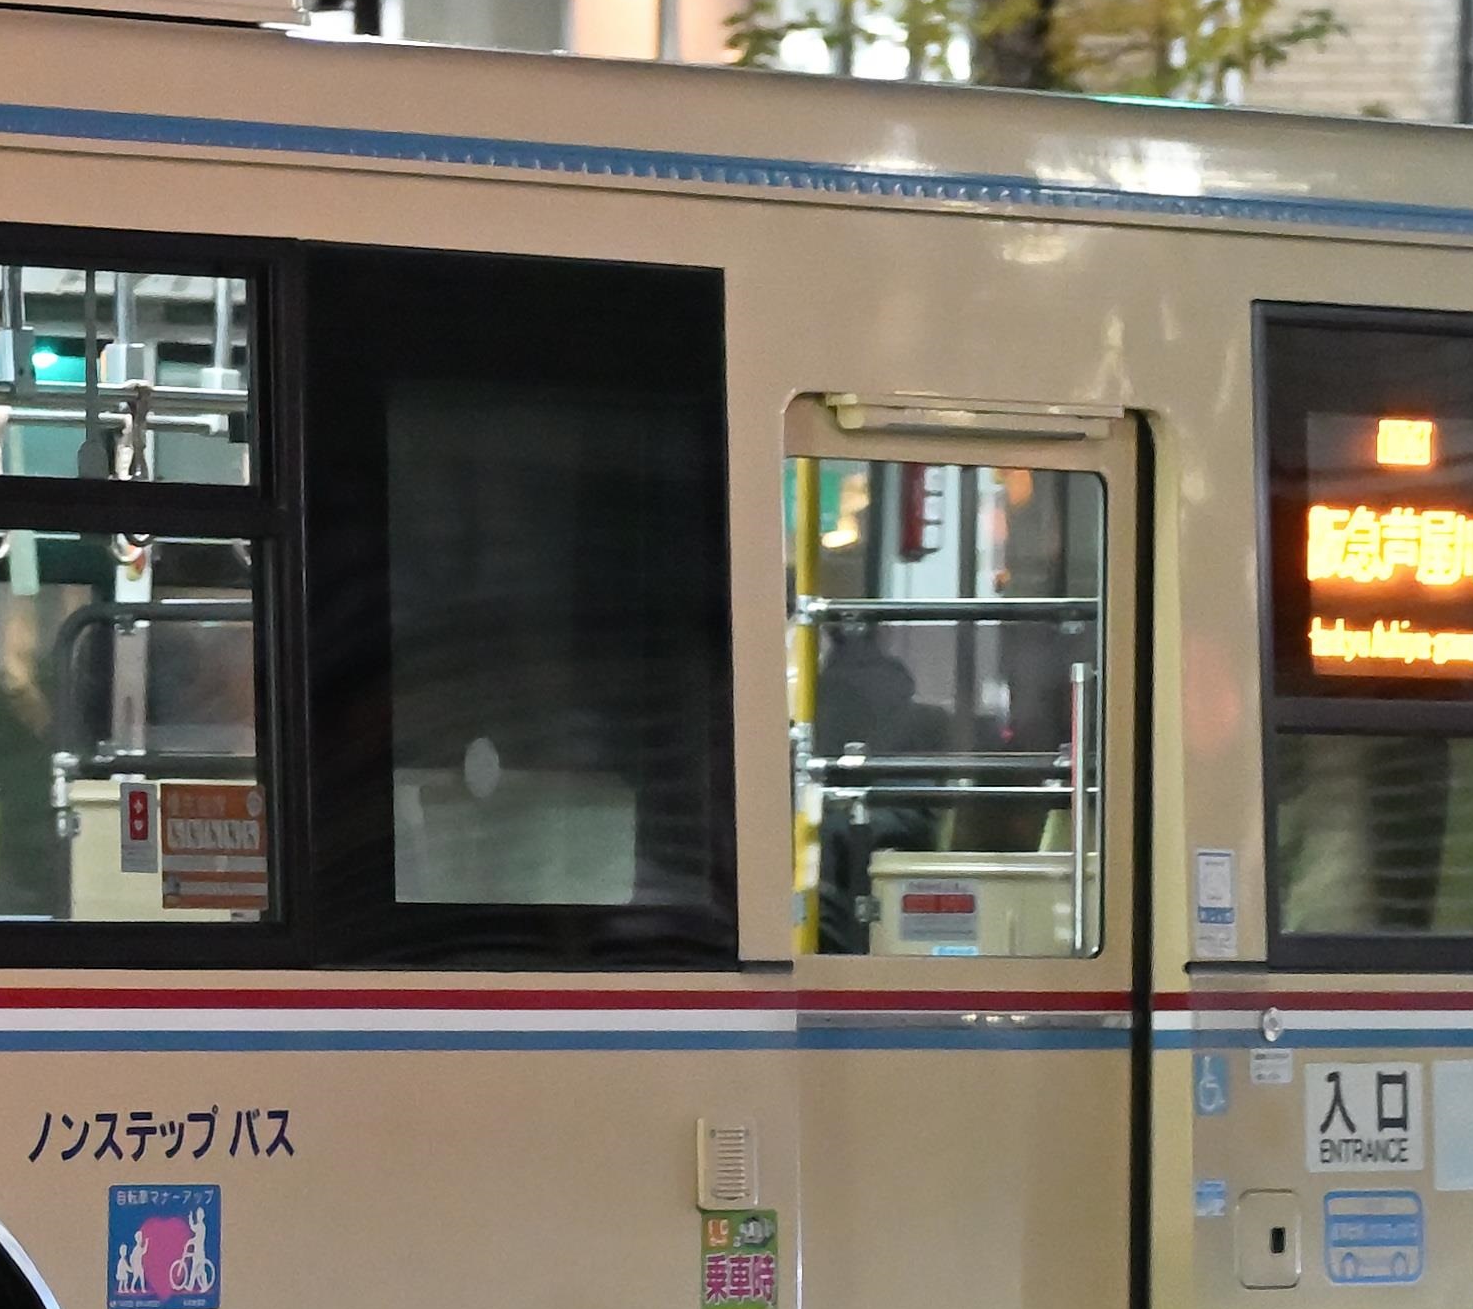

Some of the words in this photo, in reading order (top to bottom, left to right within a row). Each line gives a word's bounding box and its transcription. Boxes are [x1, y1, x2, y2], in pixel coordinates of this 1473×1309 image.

[1320, 1071, 1408, 1133] 入口
[28, 1104, 296, 1163] ノンステップバス
[1320, 1138, 1409, 1164] ENTRANCE
[706, 1252, 775, 1307] 乗車時
